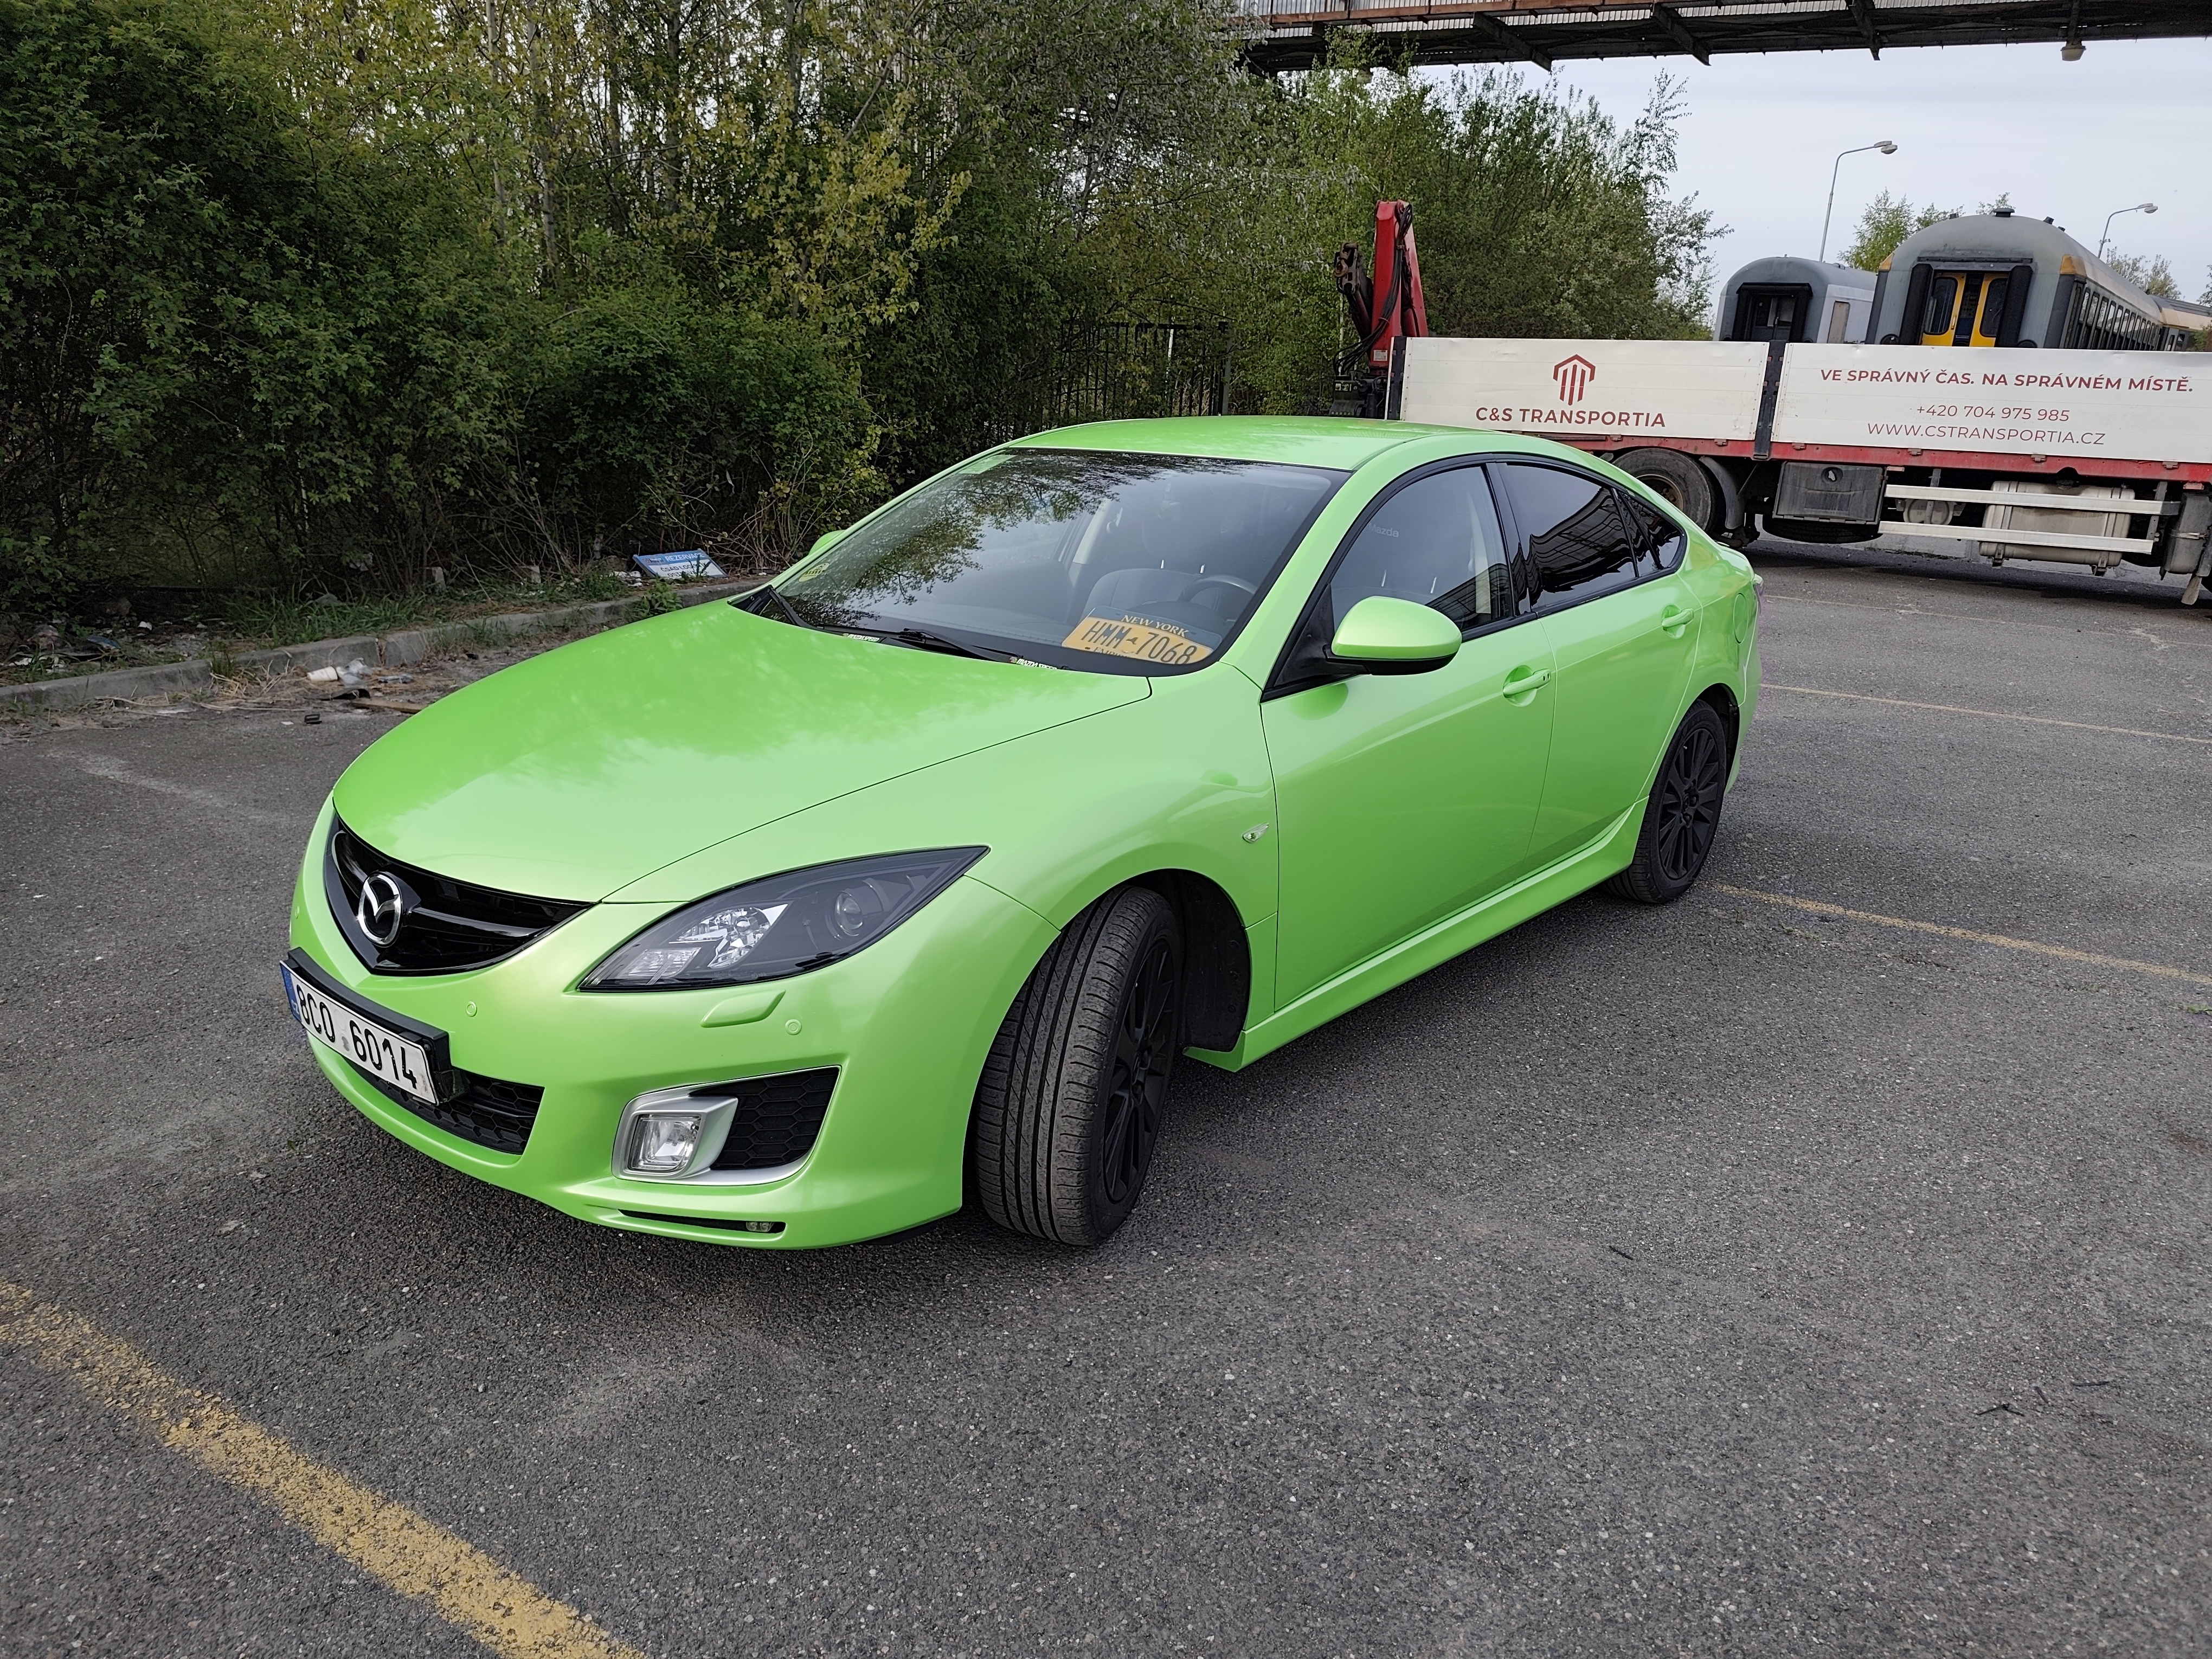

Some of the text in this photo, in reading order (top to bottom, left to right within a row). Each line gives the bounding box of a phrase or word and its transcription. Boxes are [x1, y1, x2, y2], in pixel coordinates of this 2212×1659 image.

[1821, 368, 2193, 392] VE SPRÁVNÝ ČAS. NA SPRÁVNÉM MÍSTĚ.
[1476, 407, 1666, 427] C&S TRANSPORTIA
[1917, 404, 2070, 422] +420 704 975 985
[1868, 423, 2106, 445] WWW.CSTRANSPORTIA.CZ
[1369, 523, 1399, 537] Mazda
[1121, 615, 1189, 638] NEW YORK
[291, 999, 300, 1015] CZ
[349, 1020, 417, 1090] 6014
